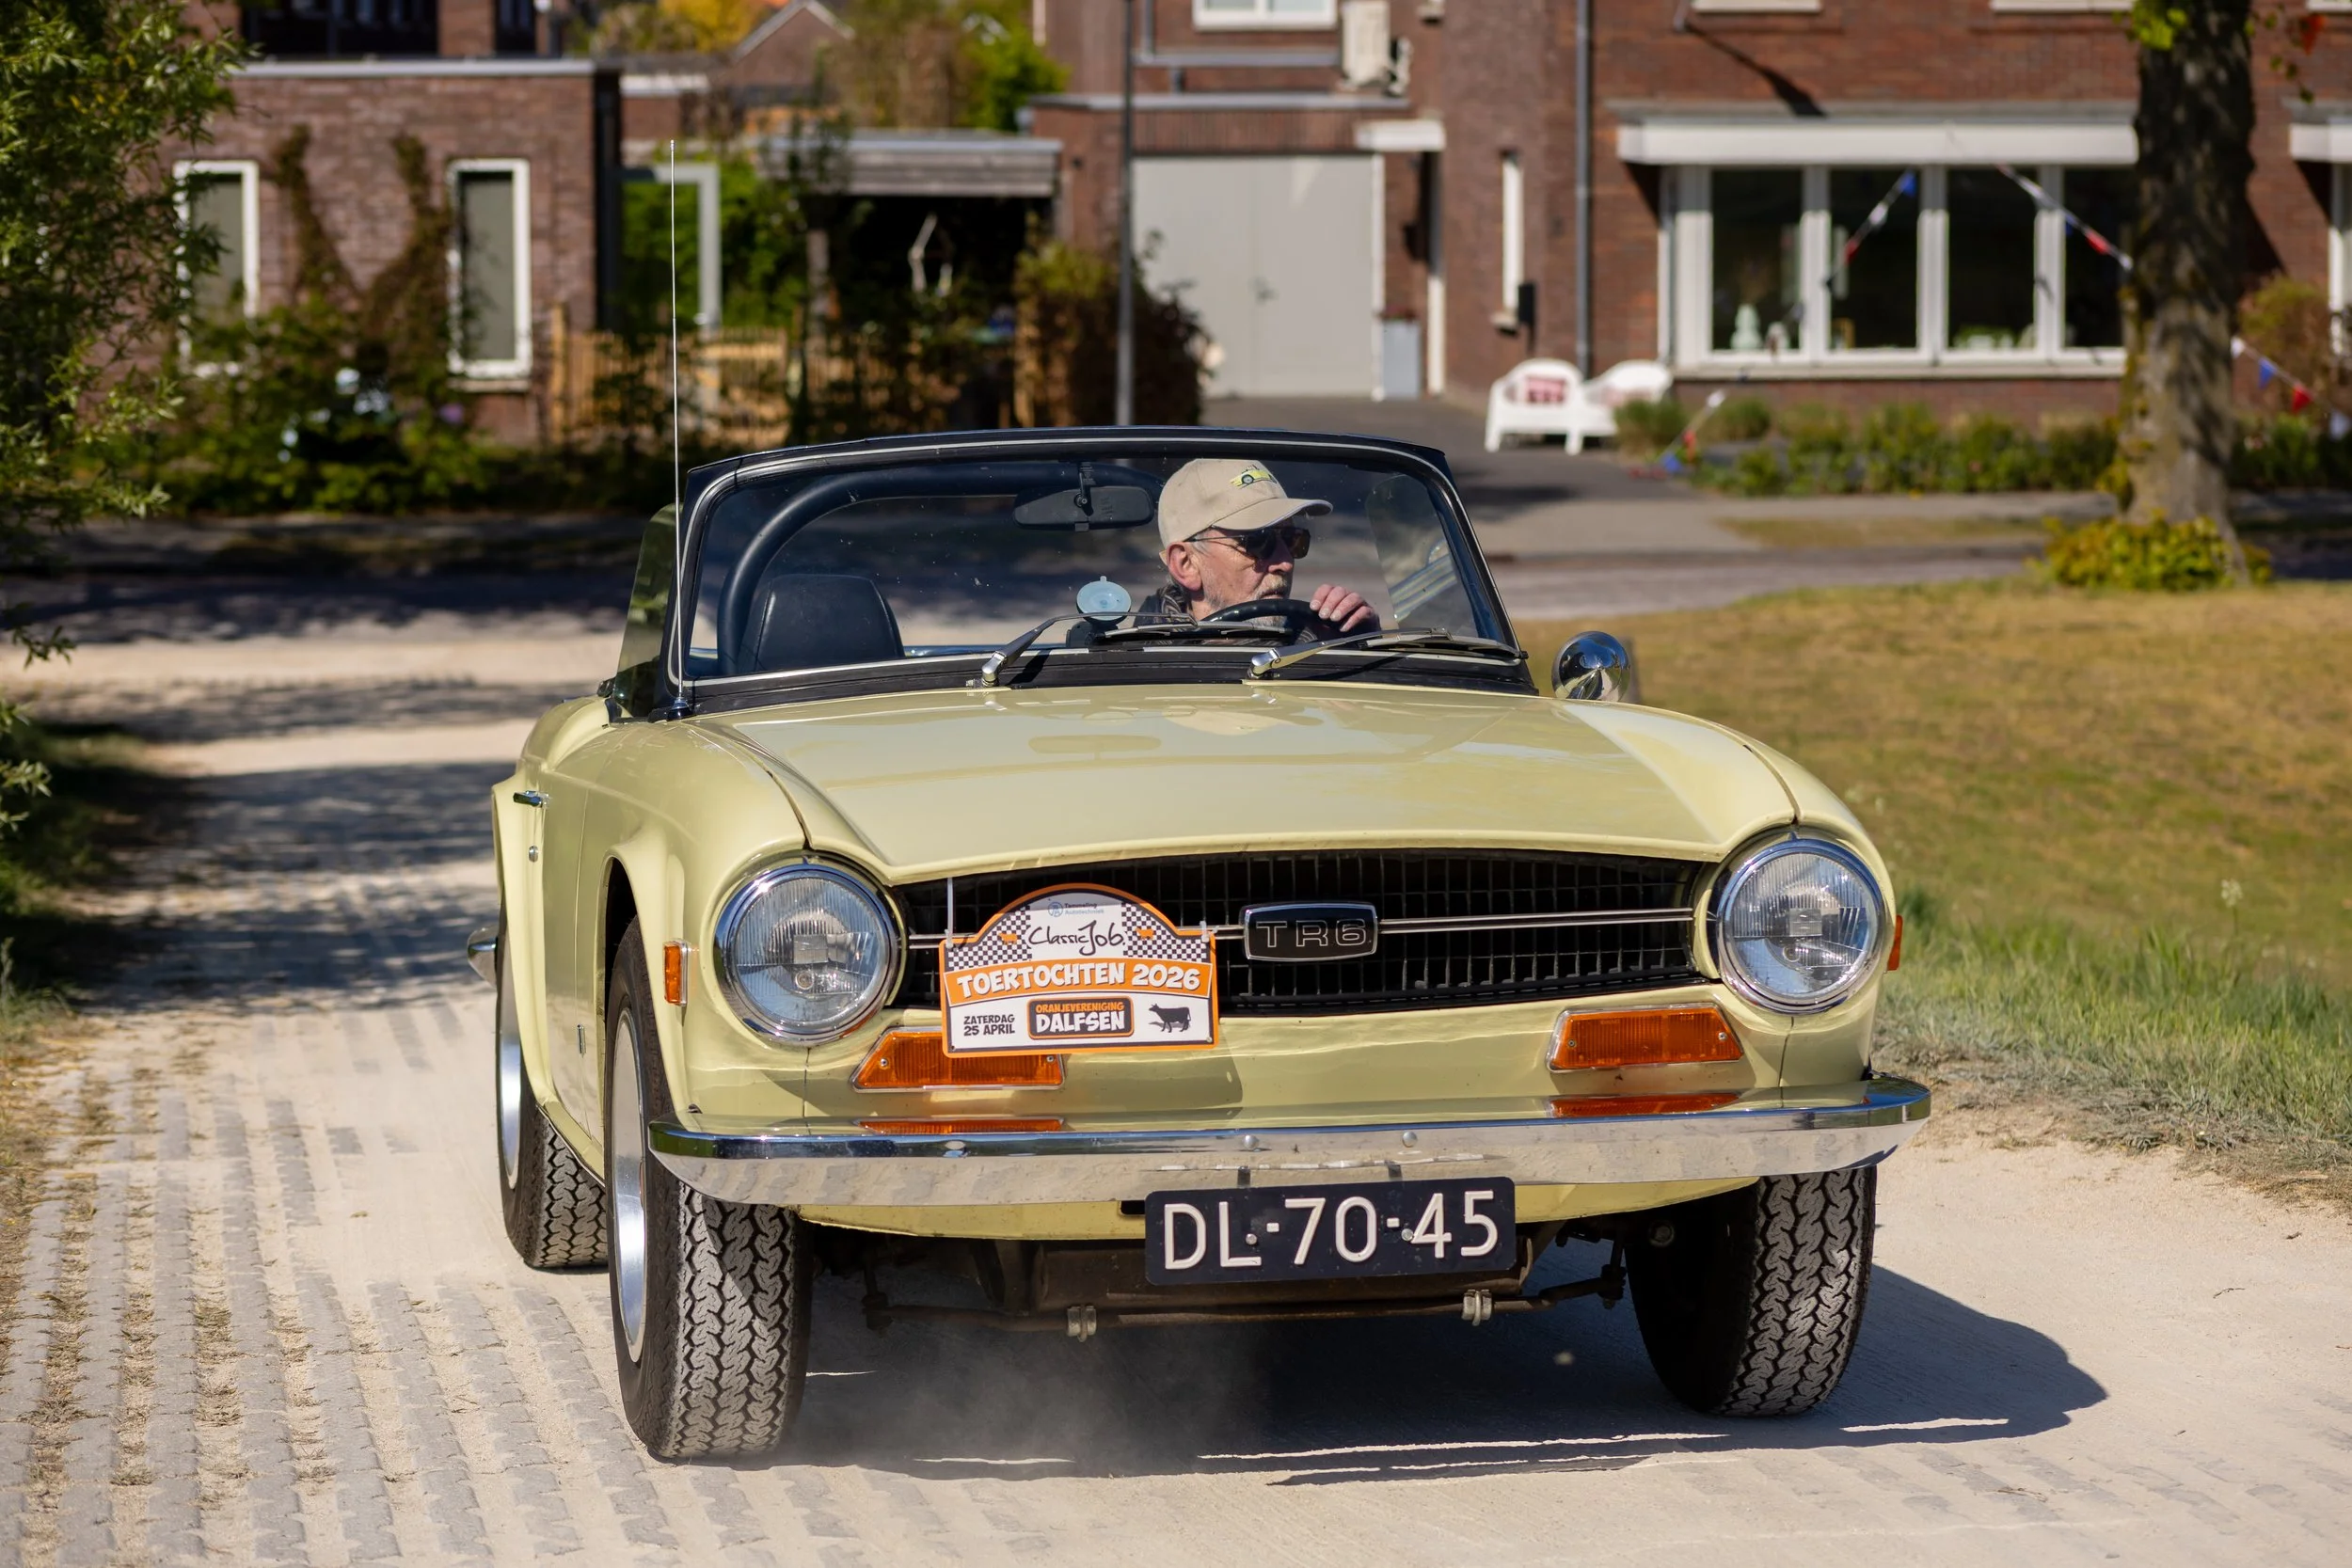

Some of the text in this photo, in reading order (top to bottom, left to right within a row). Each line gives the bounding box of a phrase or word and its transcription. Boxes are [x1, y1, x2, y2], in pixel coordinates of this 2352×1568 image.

[1256, 918, 1367, 948] TR6
[957, 962, 1200, 999] TOERTOCHTEN 2026
[963, 1014, 1015, 1025] ZATERDAG
[1035, 1002, 1125, 1014] ORANJEVERENIGING
[963, 1024, 1016, 1037] 25 APRIL
[1035, 1011, 1125, 1034] DALFSEN
[1164, 1190, 1499, 1271] DL-70-45
